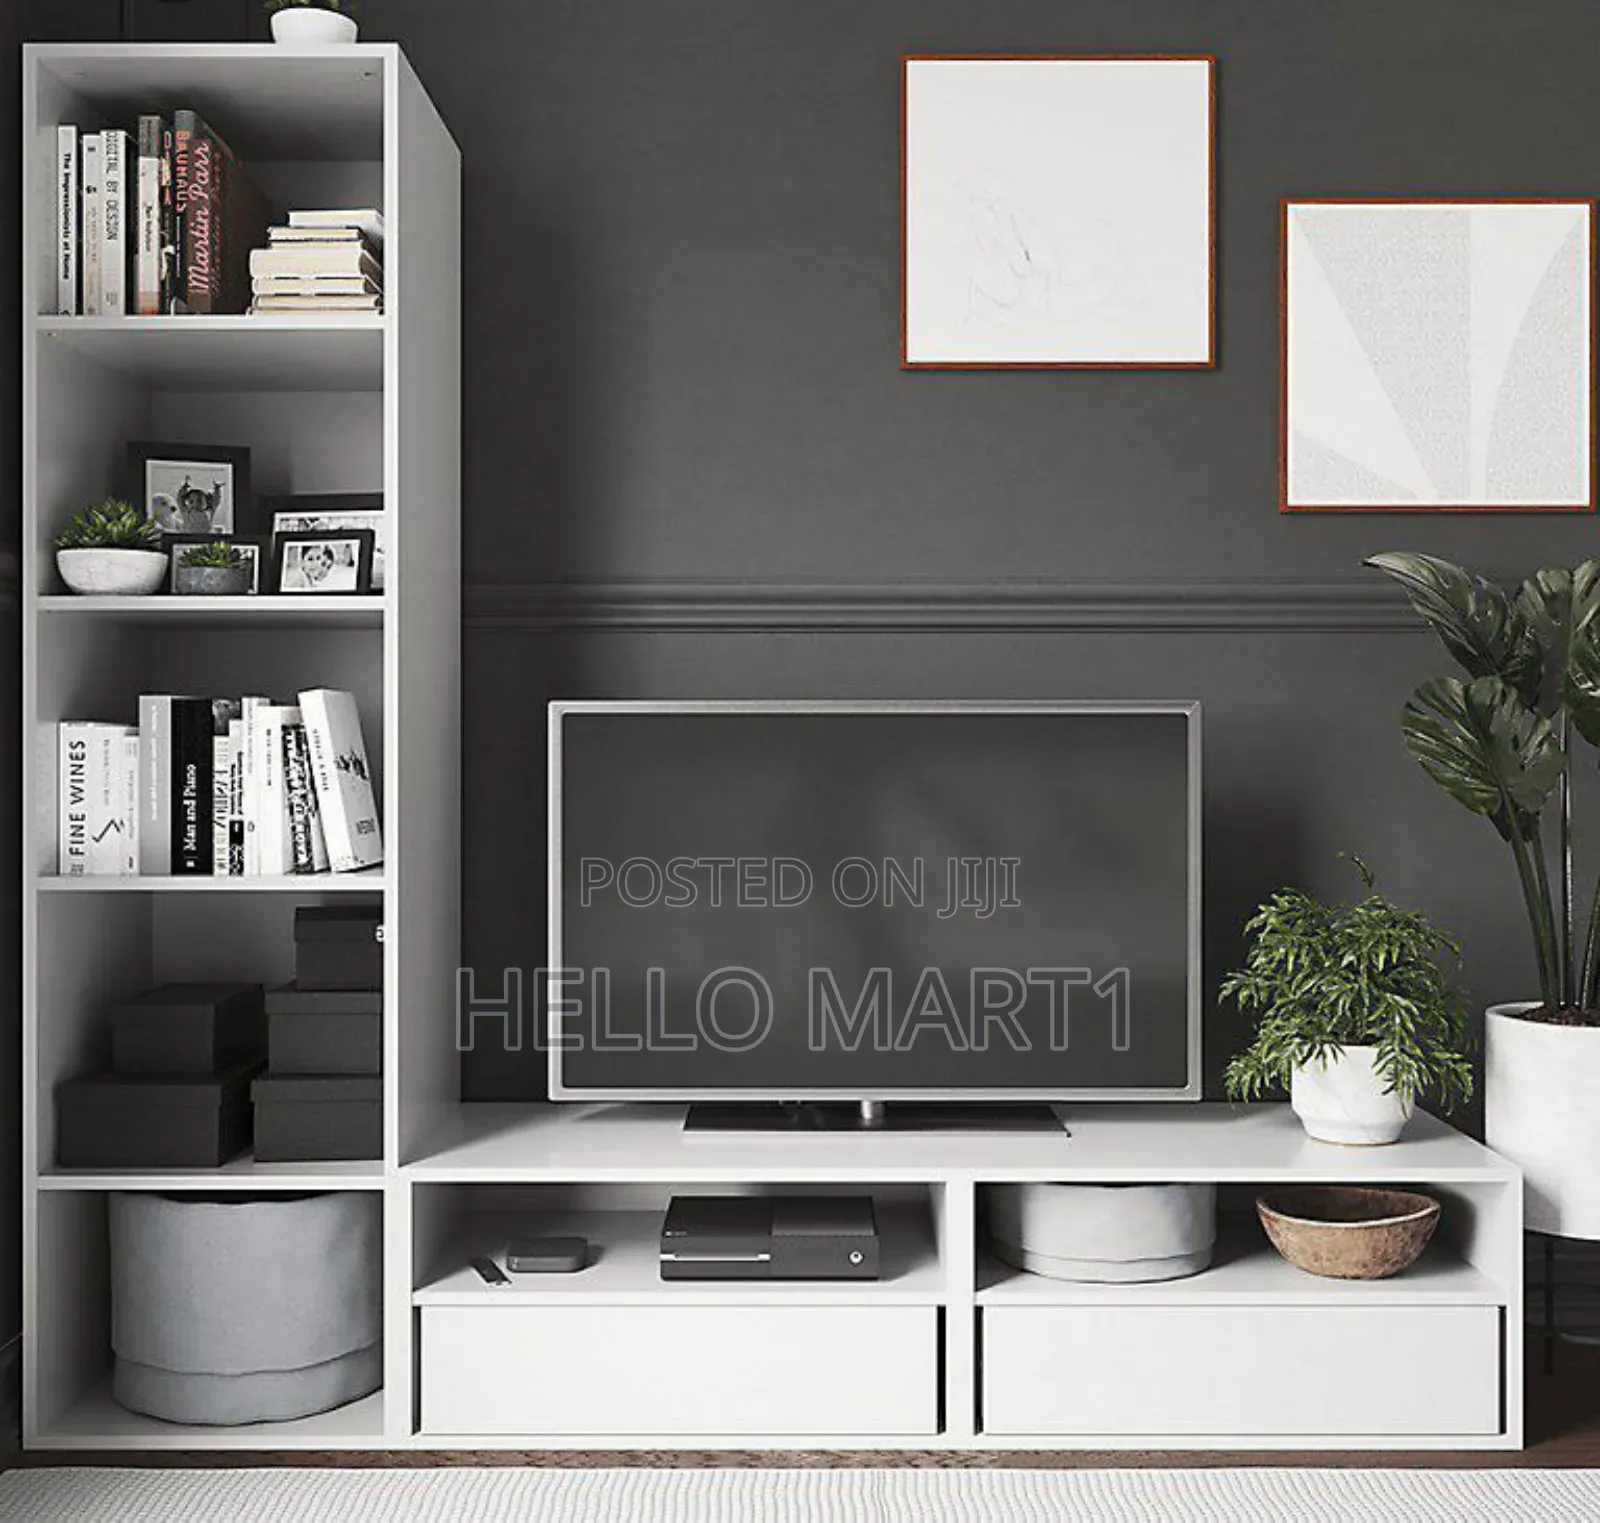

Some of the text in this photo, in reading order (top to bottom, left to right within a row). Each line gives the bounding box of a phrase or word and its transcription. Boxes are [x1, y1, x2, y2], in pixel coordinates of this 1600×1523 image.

[63, 152, 72, 169] The
[105, 181, 118, 193] BY
[176, 129, 190, 212] BAUHAUS
[61, 172, 72, 239] Impressionists
[105, 200, 118, 241] DESIGN
[188, 142, 210, 294] Martin Parr
[63, 253, 72, 280] Home
[68, 740, 86, 805] WINES
[68, 812, 86, 856] FINE
[182, 763, 197, 851] Man and Piano
